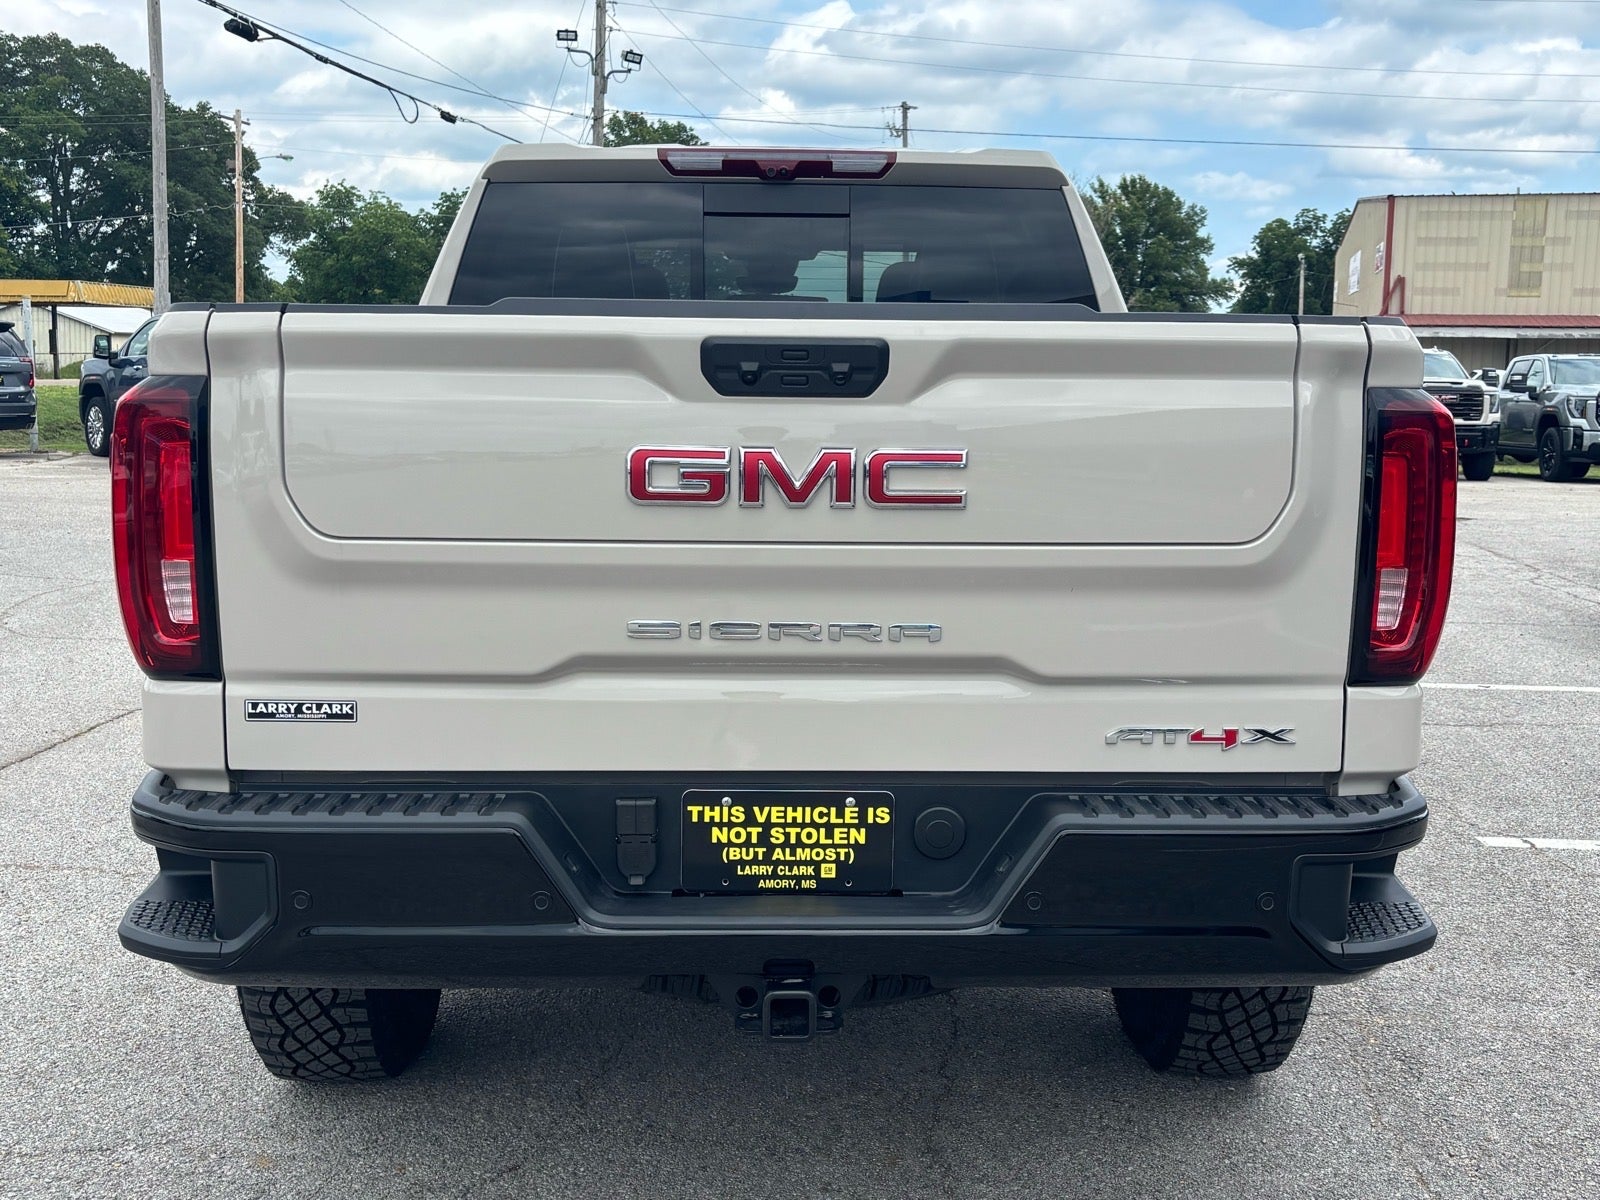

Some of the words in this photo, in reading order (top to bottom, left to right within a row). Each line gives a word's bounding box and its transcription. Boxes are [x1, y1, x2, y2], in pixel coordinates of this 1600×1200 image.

[625, 444, 968, 510] GMC
[626, 619, 943, 643] SIERRA
[248, 703, 298, 713] LARRY
[302, 703, 353, 714] CLARK
[1105, 726, 1296, 752] AT4X
[686, 805, 746, 824] THIS
[752, 806, 859, 825] VEHICLE
[867, 807, 891, 825] IS
[711, 826, 763, 844] NOT
[769, 827, 866, 845] STOLEN
[722, 847, 766, 864] (BUT
[772, 848, 855, 864] ALMOST)
[737, 864, 774, 876] LARRY
[777, 865, 816, 877] CLARK
[757, 879, 799, 890] AMORY,
[801, 880, 817, 889] MS
